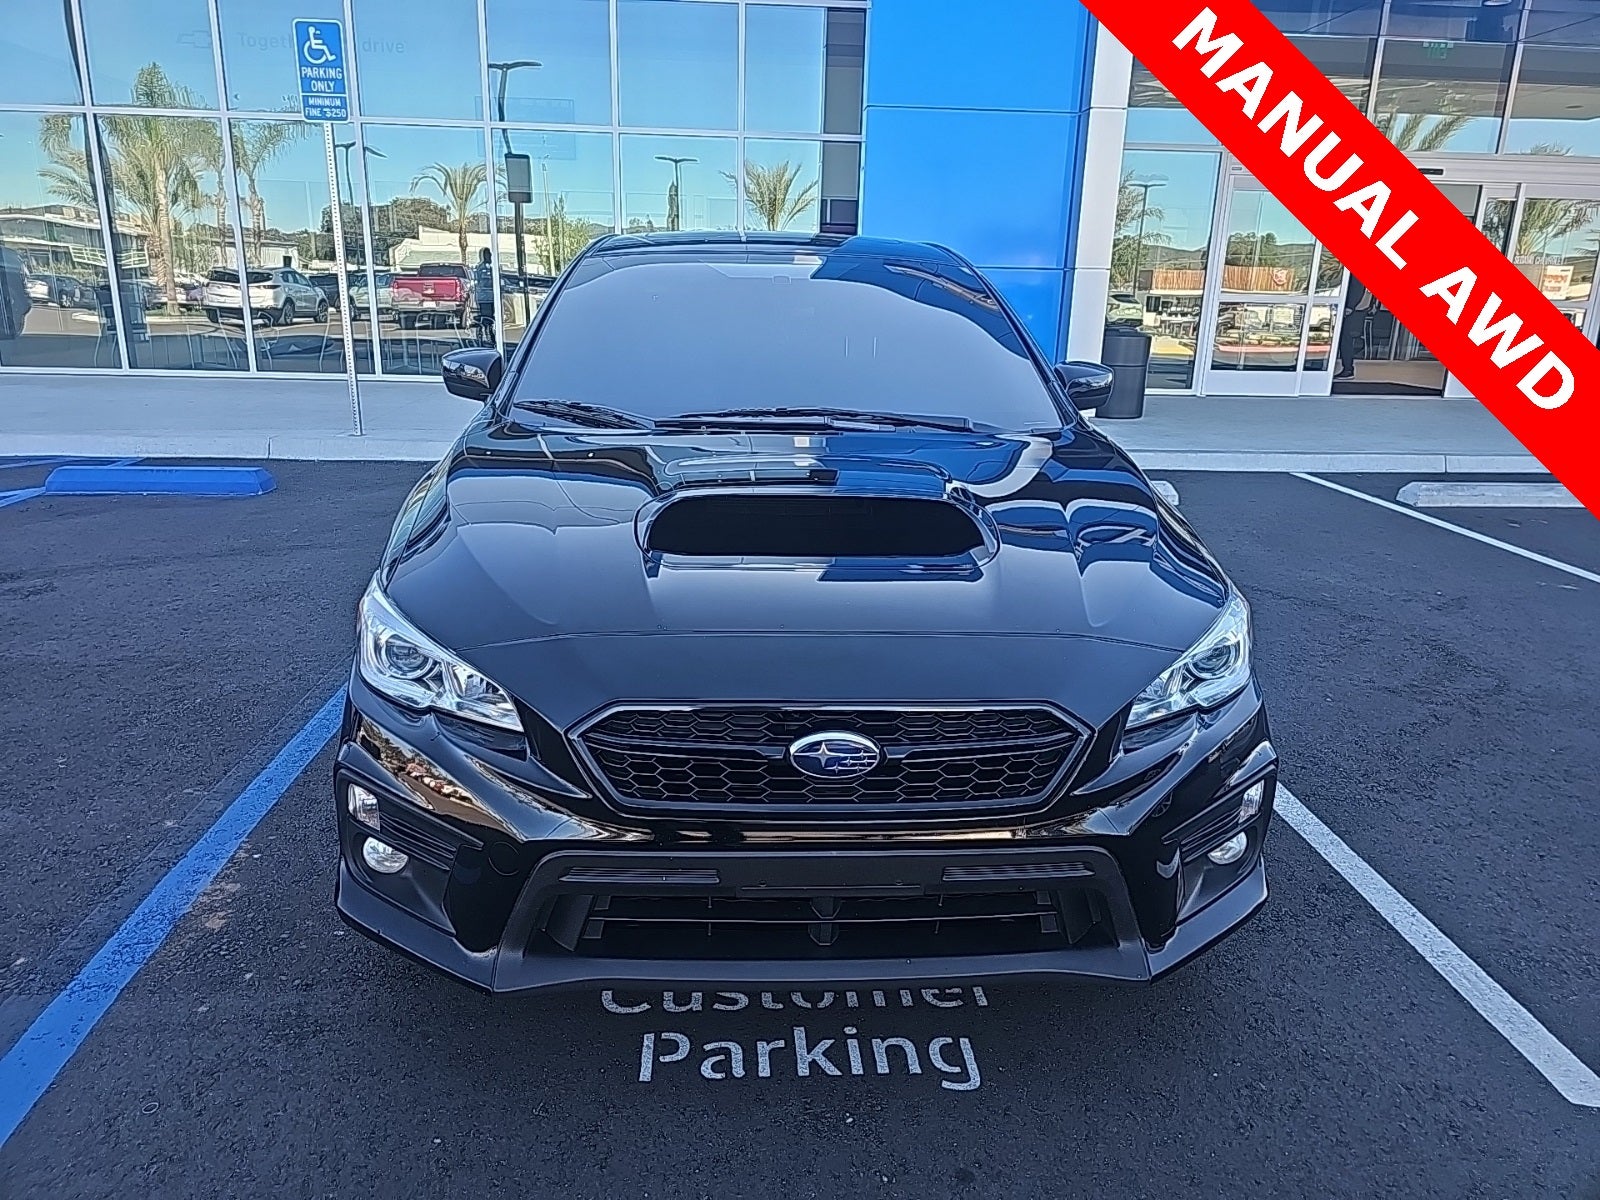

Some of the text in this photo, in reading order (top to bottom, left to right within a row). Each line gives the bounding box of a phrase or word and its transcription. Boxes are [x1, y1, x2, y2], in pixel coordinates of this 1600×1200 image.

[301, 67, 343, 79] PARKING
[311, 81, 335, 92] ONLY
[308, 97, 342, 107] MINIMUM
[305, 107, 347, 118] FINE $250
[638, 1026, 981, 1090] Parking
